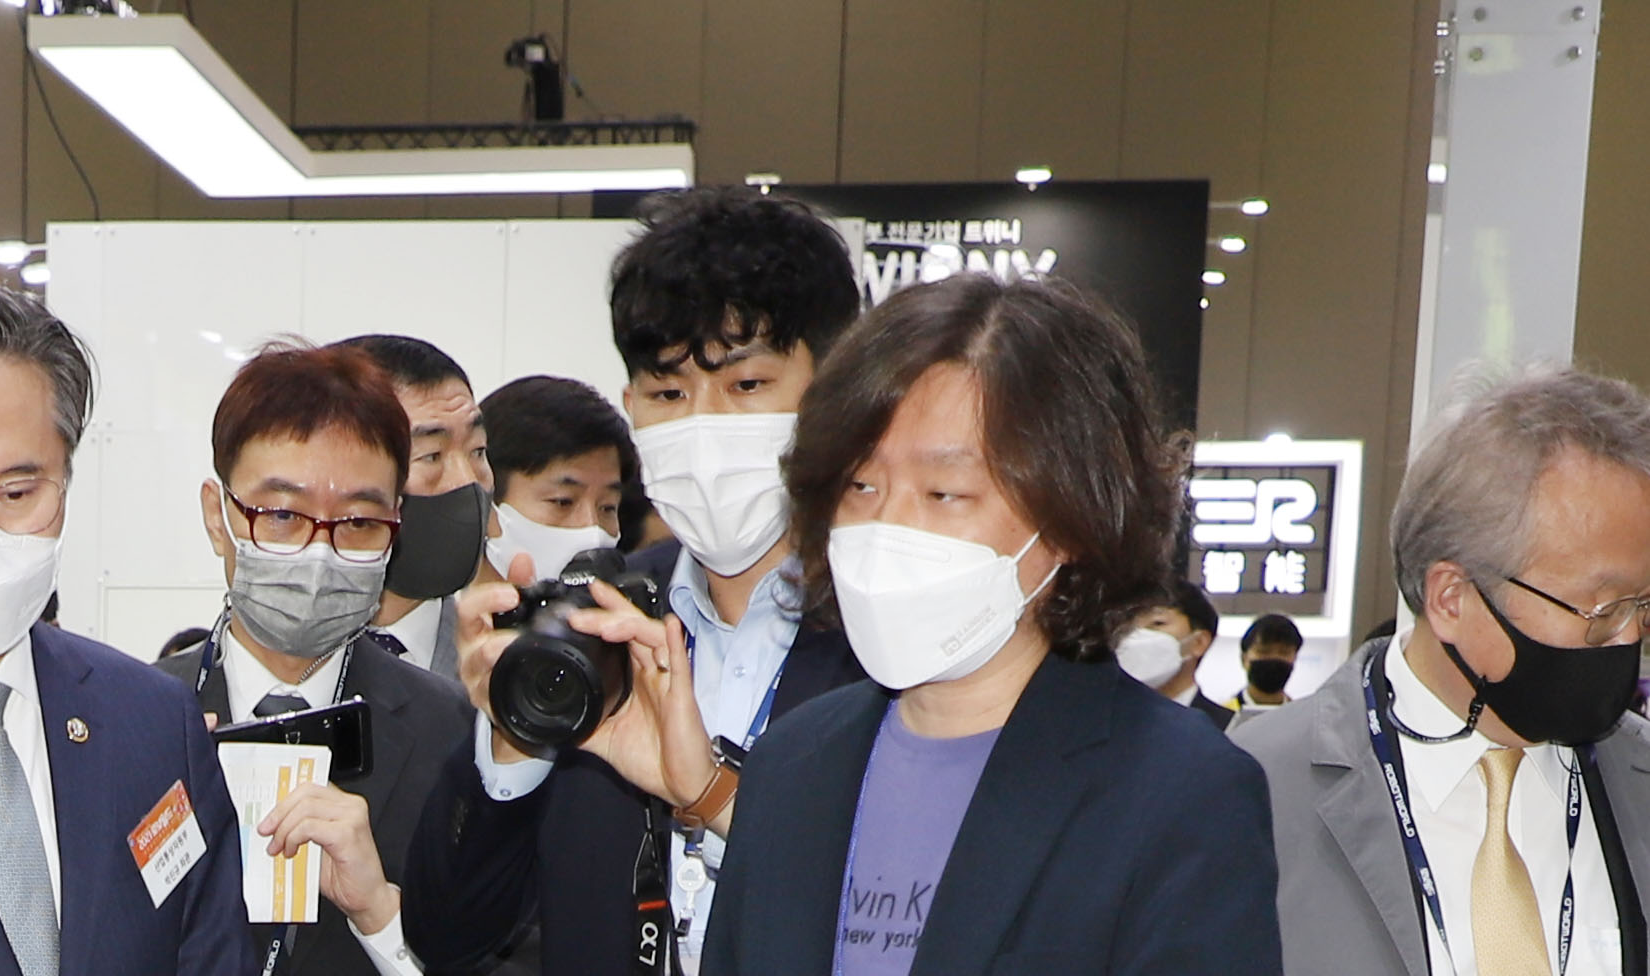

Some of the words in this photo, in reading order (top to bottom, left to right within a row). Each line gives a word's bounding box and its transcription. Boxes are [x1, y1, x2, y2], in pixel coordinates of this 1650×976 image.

[963, 217, 1022, 245] 트위니
[564, 575, 596, 586] SONY
[1383, 762, 1416, 839] ROBOTWORLD
[851, 875, 896, 919] vin
